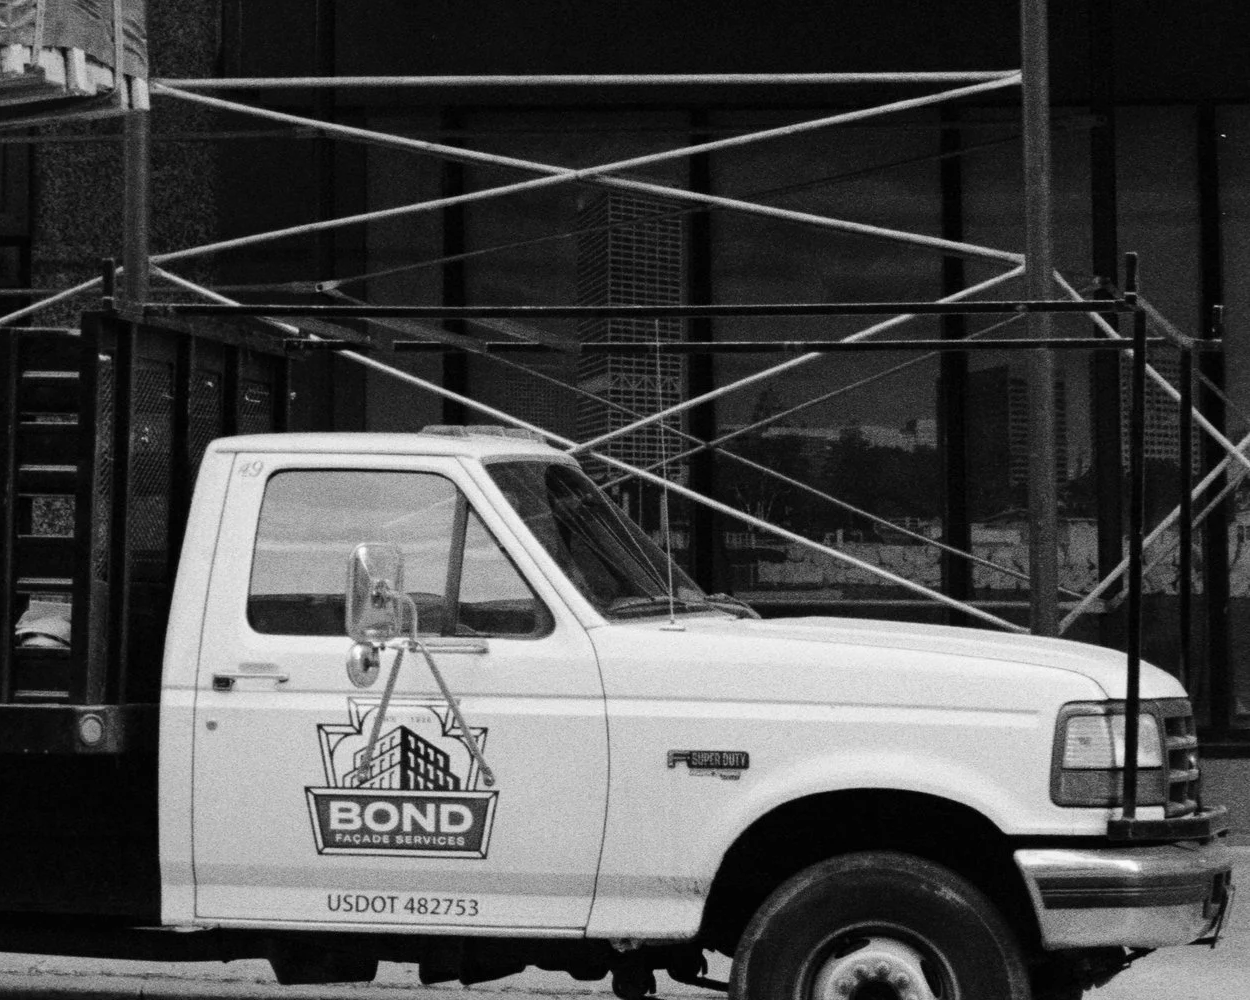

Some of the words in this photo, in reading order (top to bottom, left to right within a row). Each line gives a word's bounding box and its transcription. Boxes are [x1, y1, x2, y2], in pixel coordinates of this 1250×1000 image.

[722, 752, 747, 767] DUTY
[329, 800, 474, 834] BOND
[334, 833, 391, 846] FAÇADE
[395, 834, 466, 846] SERVICES
[327, 894, 399, 914] USDOT
[403, 896, 480, 917] 482753
